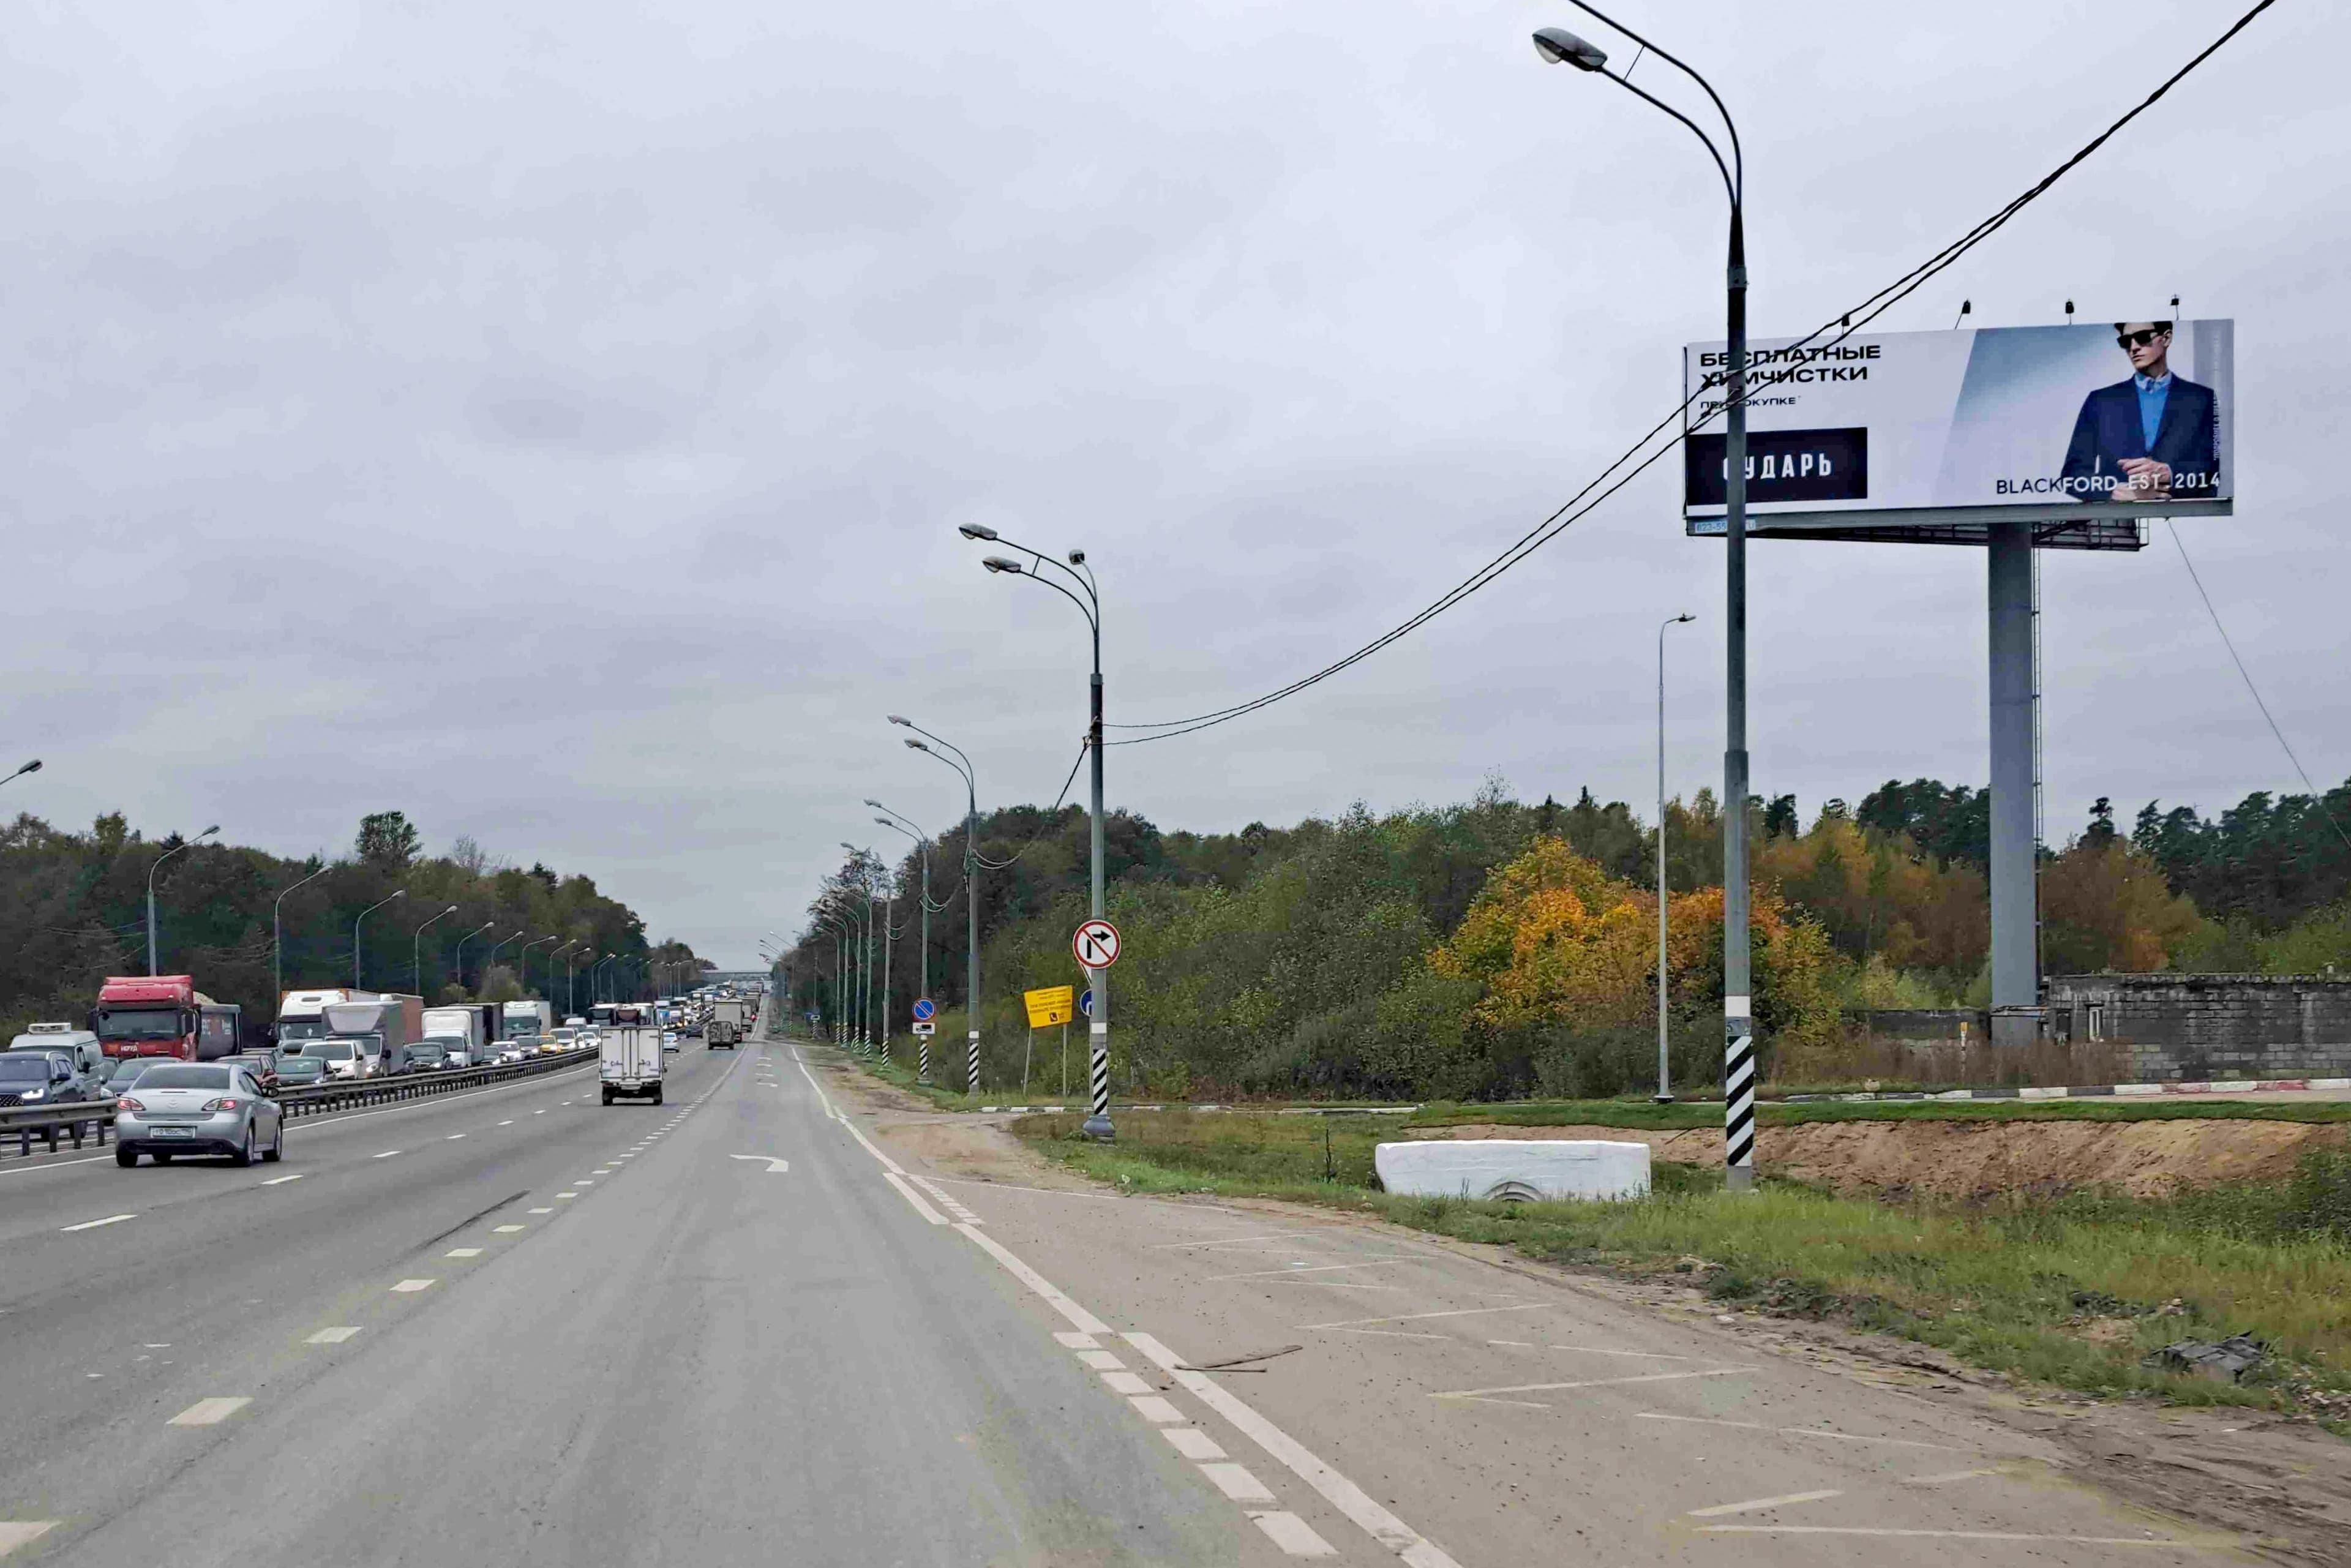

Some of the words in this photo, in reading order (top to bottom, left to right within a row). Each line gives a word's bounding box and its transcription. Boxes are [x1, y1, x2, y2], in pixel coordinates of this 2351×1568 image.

[1742, 397, 1796, 407] ОКУПКЕ
[1997, 475, 2117, 494] BLACKFORD
[2128, 473, 2171, 490] EST.
[2174, 471, 2220, 489] 2014
